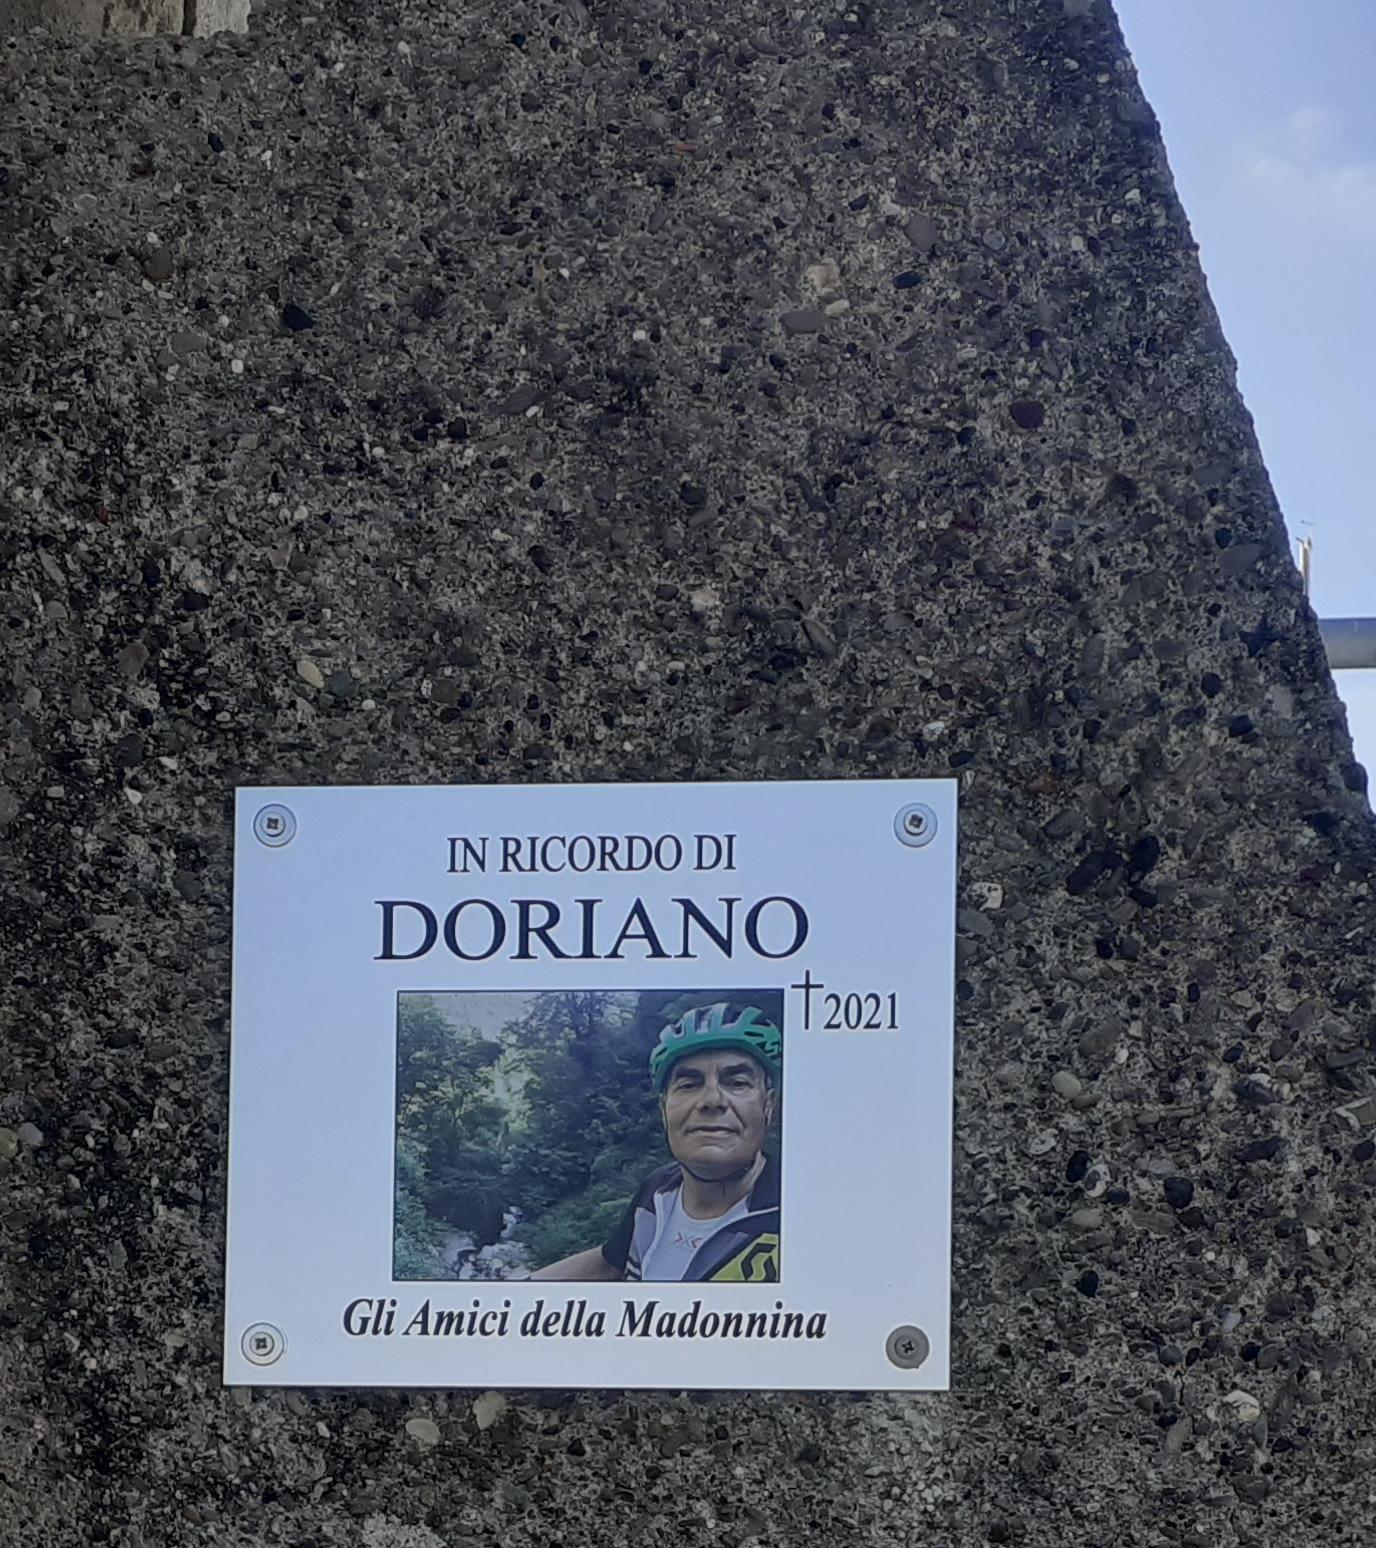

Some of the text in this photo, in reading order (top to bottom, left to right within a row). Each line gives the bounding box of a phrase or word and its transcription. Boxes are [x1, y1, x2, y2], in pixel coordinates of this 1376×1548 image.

[446, 834, 737, 873] IN RICORDO DI
[373, 896, 809, 961] DORIANO
[343, 1298, 827, 1339] Gli Amici della Madonnina
